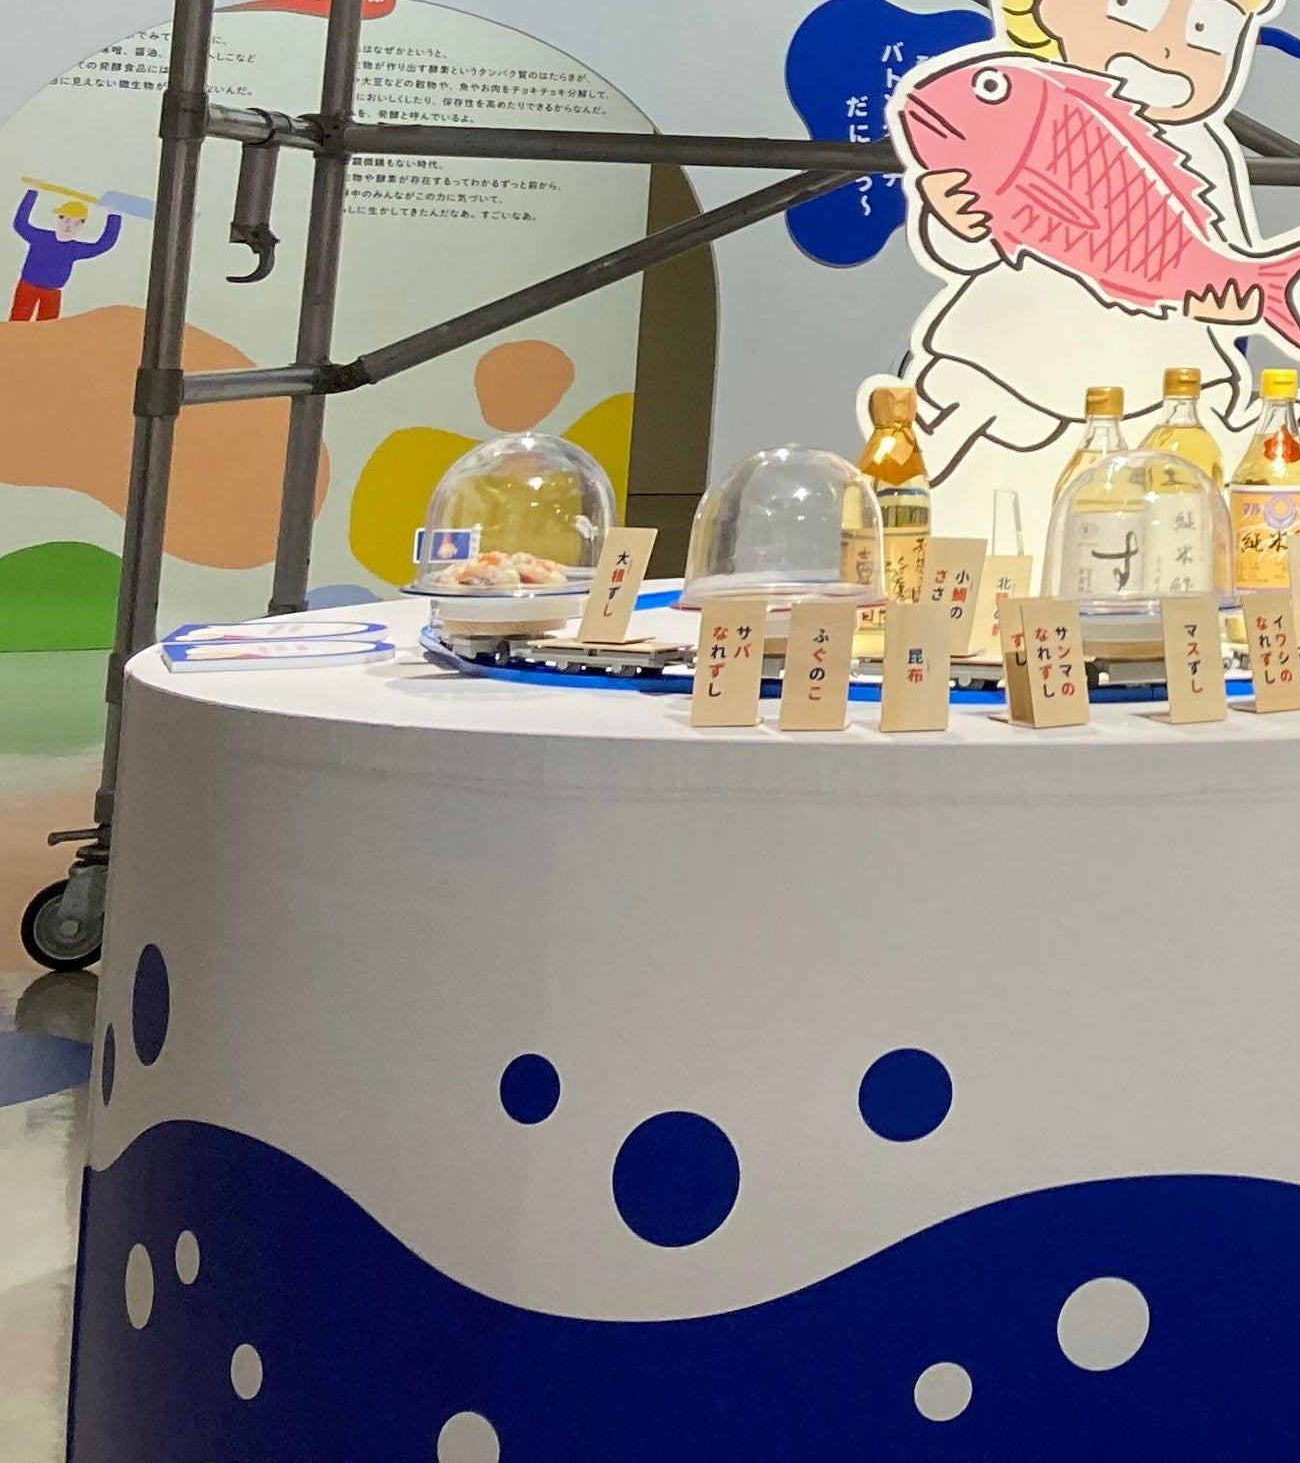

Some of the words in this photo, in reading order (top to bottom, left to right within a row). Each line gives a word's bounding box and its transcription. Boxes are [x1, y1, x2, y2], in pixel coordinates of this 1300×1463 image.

[357, 44, 448, 59] はなぜかというと、
[602, 550, 630, 617] 大根ずし
[931, 569, 948, 601] ささ
[950, 568, 970, 620] 小鯛の
[708, 625, 729, 698] なれずし
[733, 625, 753, 659] サバ
[808, 628, 830, 701] ふぐのこ
[906, 647, 924, 684] 昆布
[1034, 627, 1056, 699] なれずし
[1055, 626, 1076, 696] サンマの
[1183, 623, 1204, 694] マスずし
[1255, 615, 1276, 685] なれずし
[1272, 614, 1293, 682] イワシの
